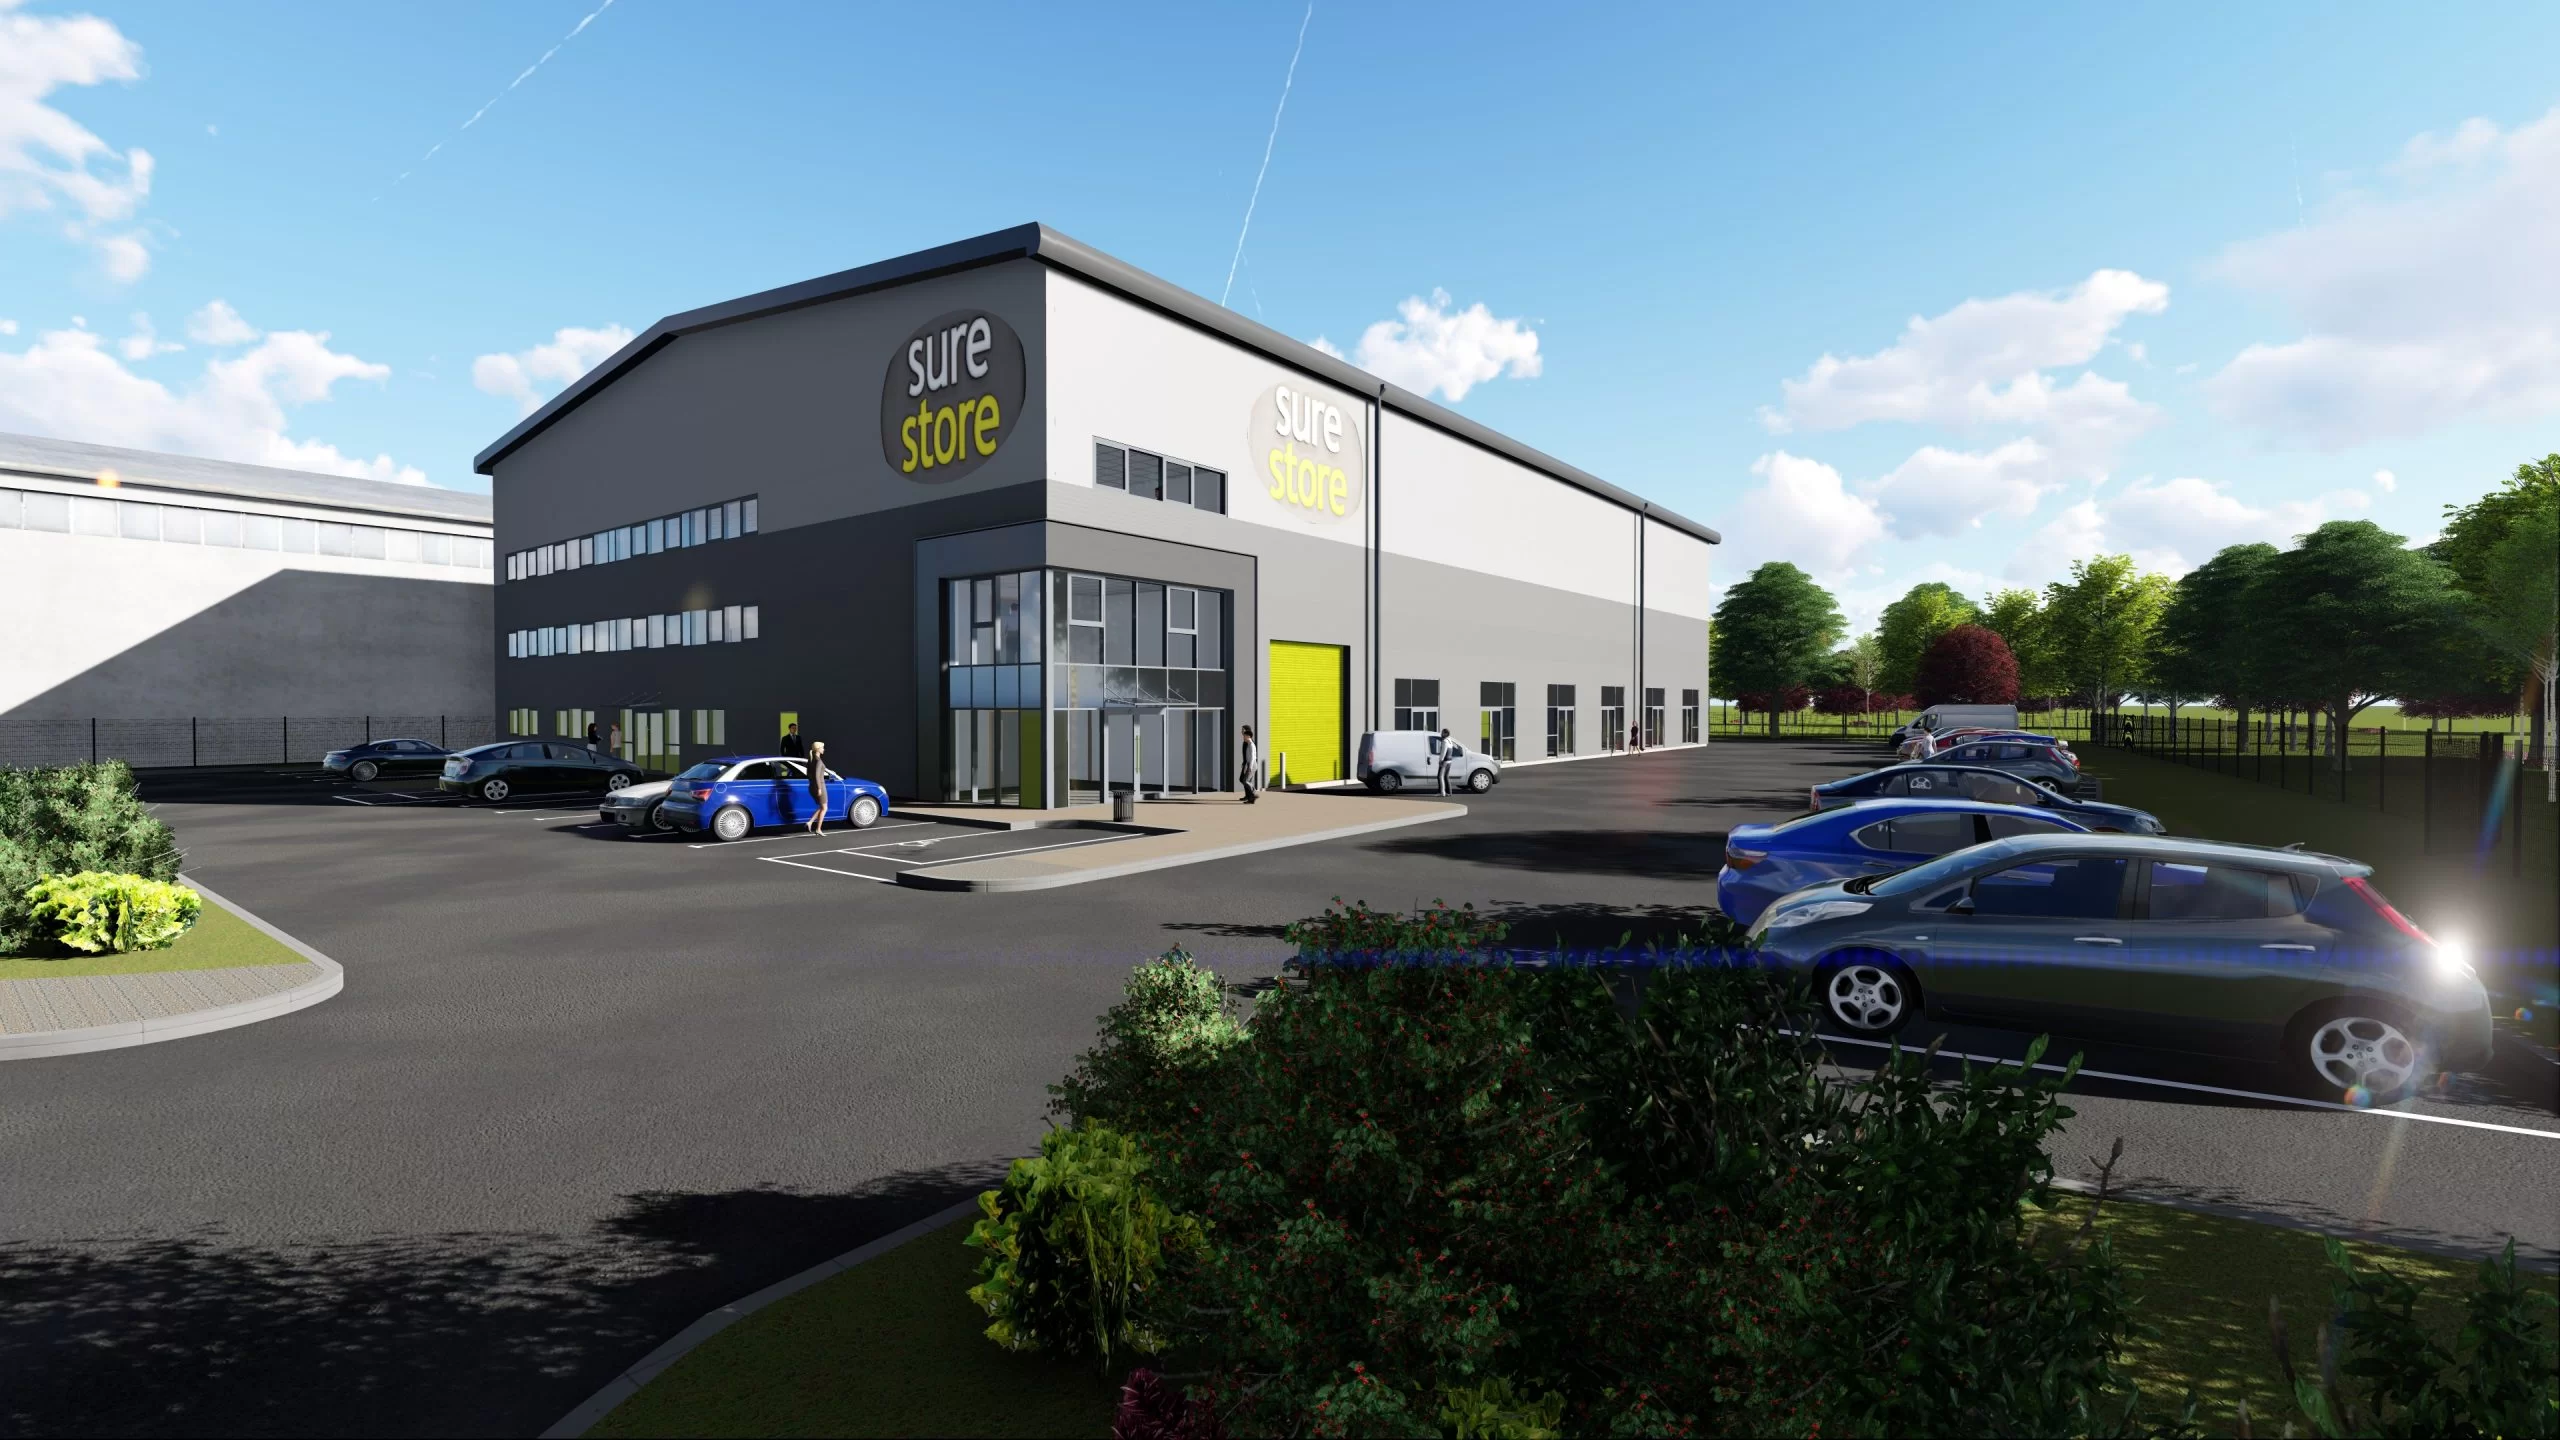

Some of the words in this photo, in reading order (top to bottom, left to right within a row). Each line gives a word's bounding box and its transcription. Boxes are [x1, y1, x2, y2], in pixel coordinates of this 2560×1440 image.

[908, 317, 992, 397] sure
[902, 394, 1000, 473] store
[1275, 386, 1343, 453] sure
[1269, 441, 1347, 517] store
